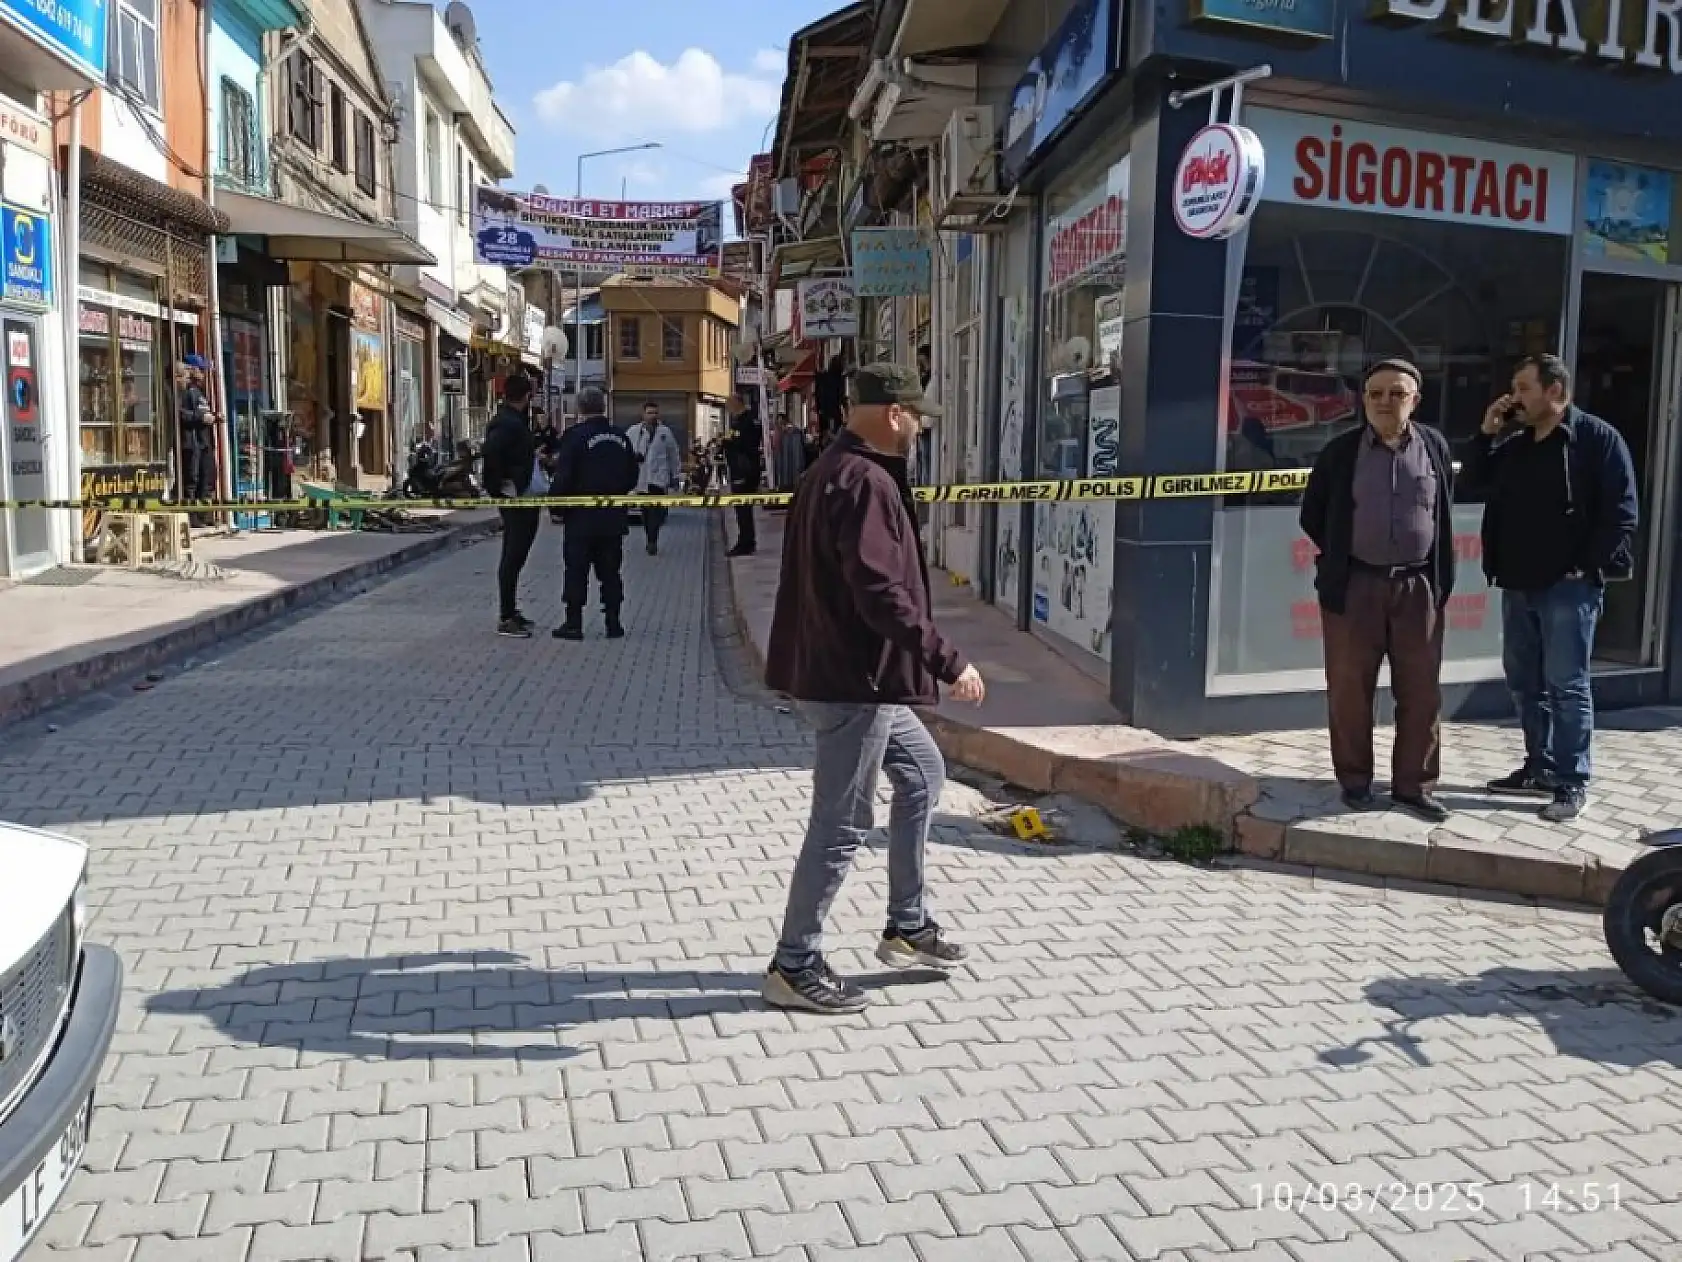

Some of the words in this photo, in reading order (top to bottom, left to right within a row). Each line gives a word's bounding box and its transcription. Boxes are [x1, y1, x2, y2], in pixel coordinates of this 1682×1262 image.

[1293, 124, 1548, 223] SİGORTACI
[600, 203, 619, 217] ET
[625, 203, 694, 219] MARKET
[496, 231, 518, 244] 28
[1269, 471, 1307, 487] POLİ
